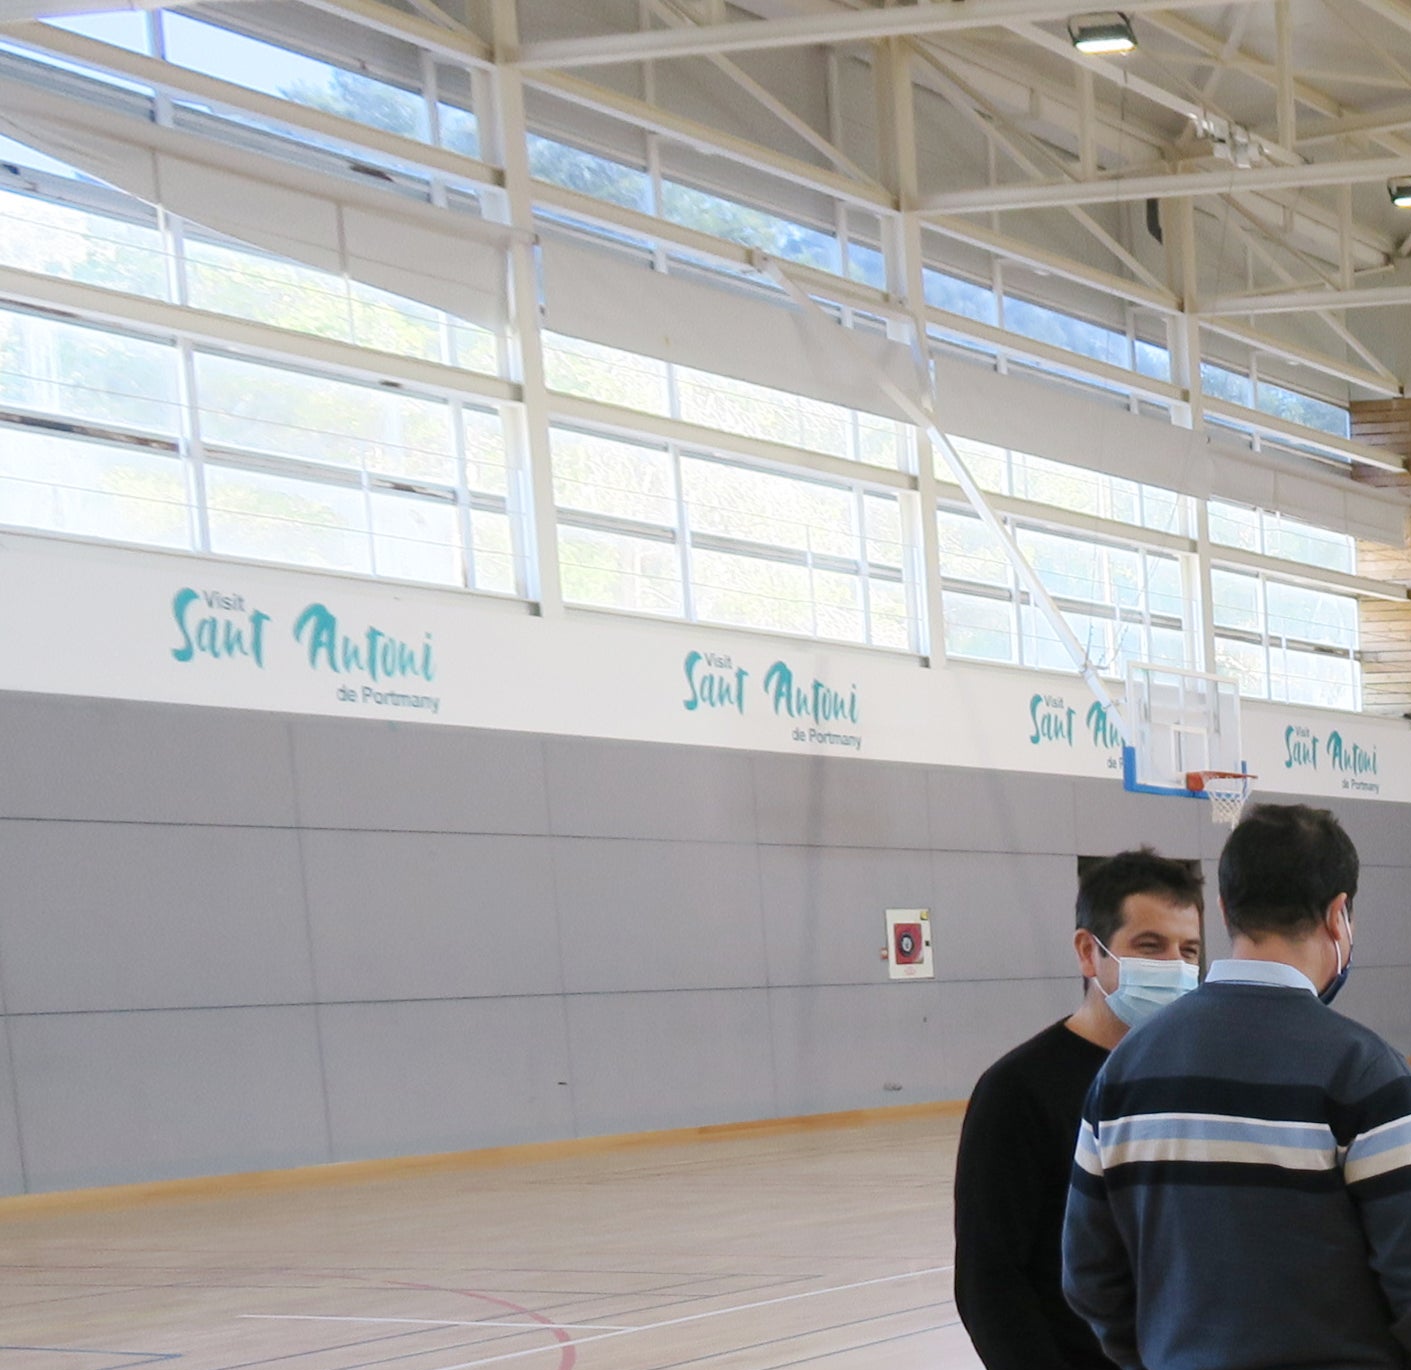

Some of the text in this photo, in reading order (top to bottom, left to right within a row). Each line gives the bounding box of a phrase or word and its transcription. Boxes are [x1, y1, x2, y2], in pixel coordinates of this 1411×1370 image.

[202, 589, 245, 612] Visit
[170, 587, 436, 683] Sant Antoni
[703, 652, 733, 670] Visit
[336, 684, 440, 713] de Portmany
[683, 650, 858, 725] Sant Antoni
[1044, 695, 1064, 709] Visit
[1029, 693, 1076, 748] Sant
[791, 727, 862, 750] de Portmany
[1284, 725, 1377, 776] Sant Antoni
